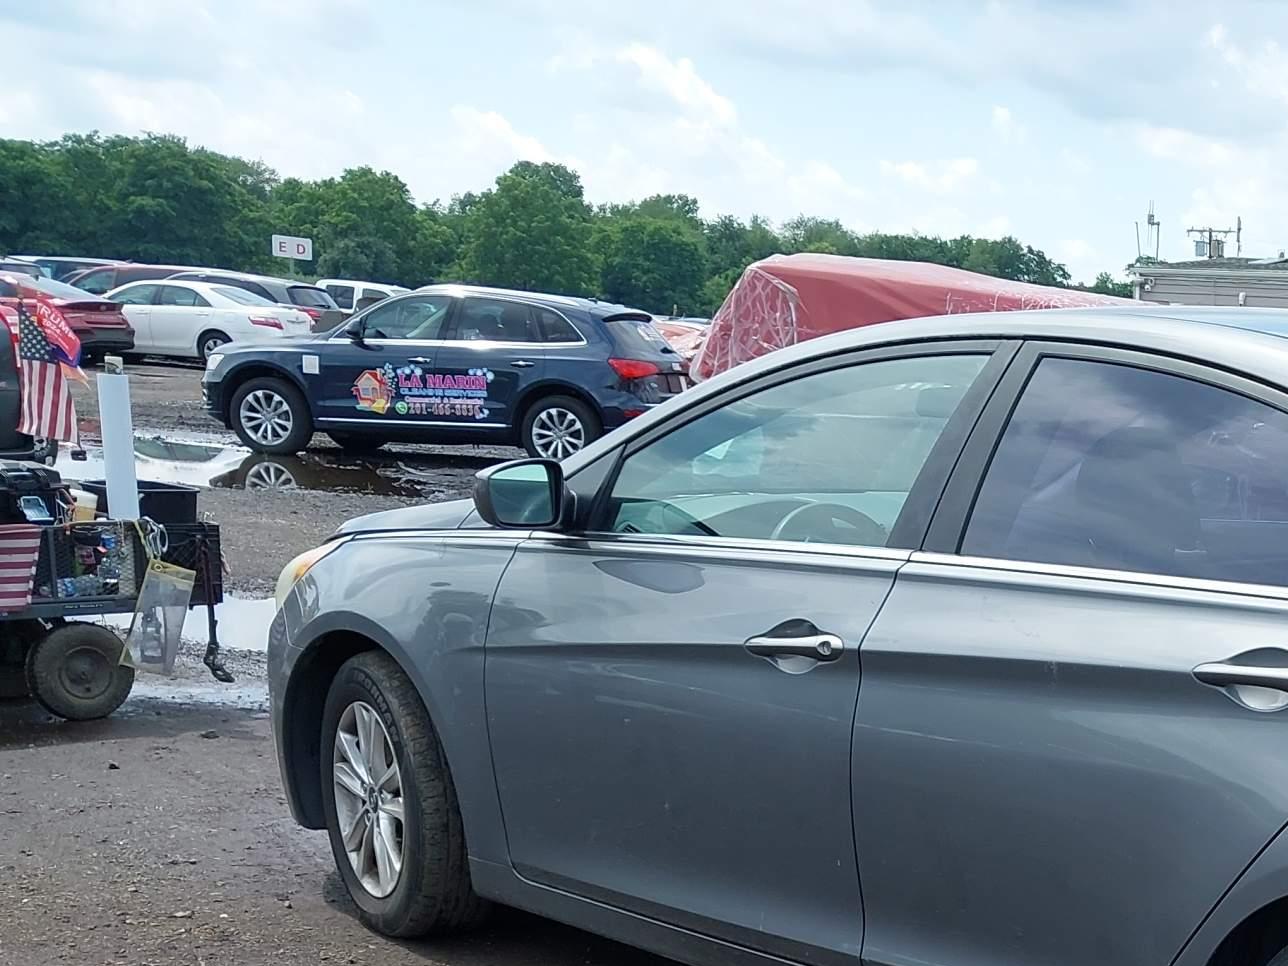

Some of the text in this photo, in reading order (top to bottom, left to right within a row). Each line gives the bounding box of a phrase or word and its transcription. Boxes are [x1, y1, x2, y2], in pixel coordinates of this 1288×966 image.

[279, 241, 306, 255] E D
[399, 372, 487, 389] LA MARIN
